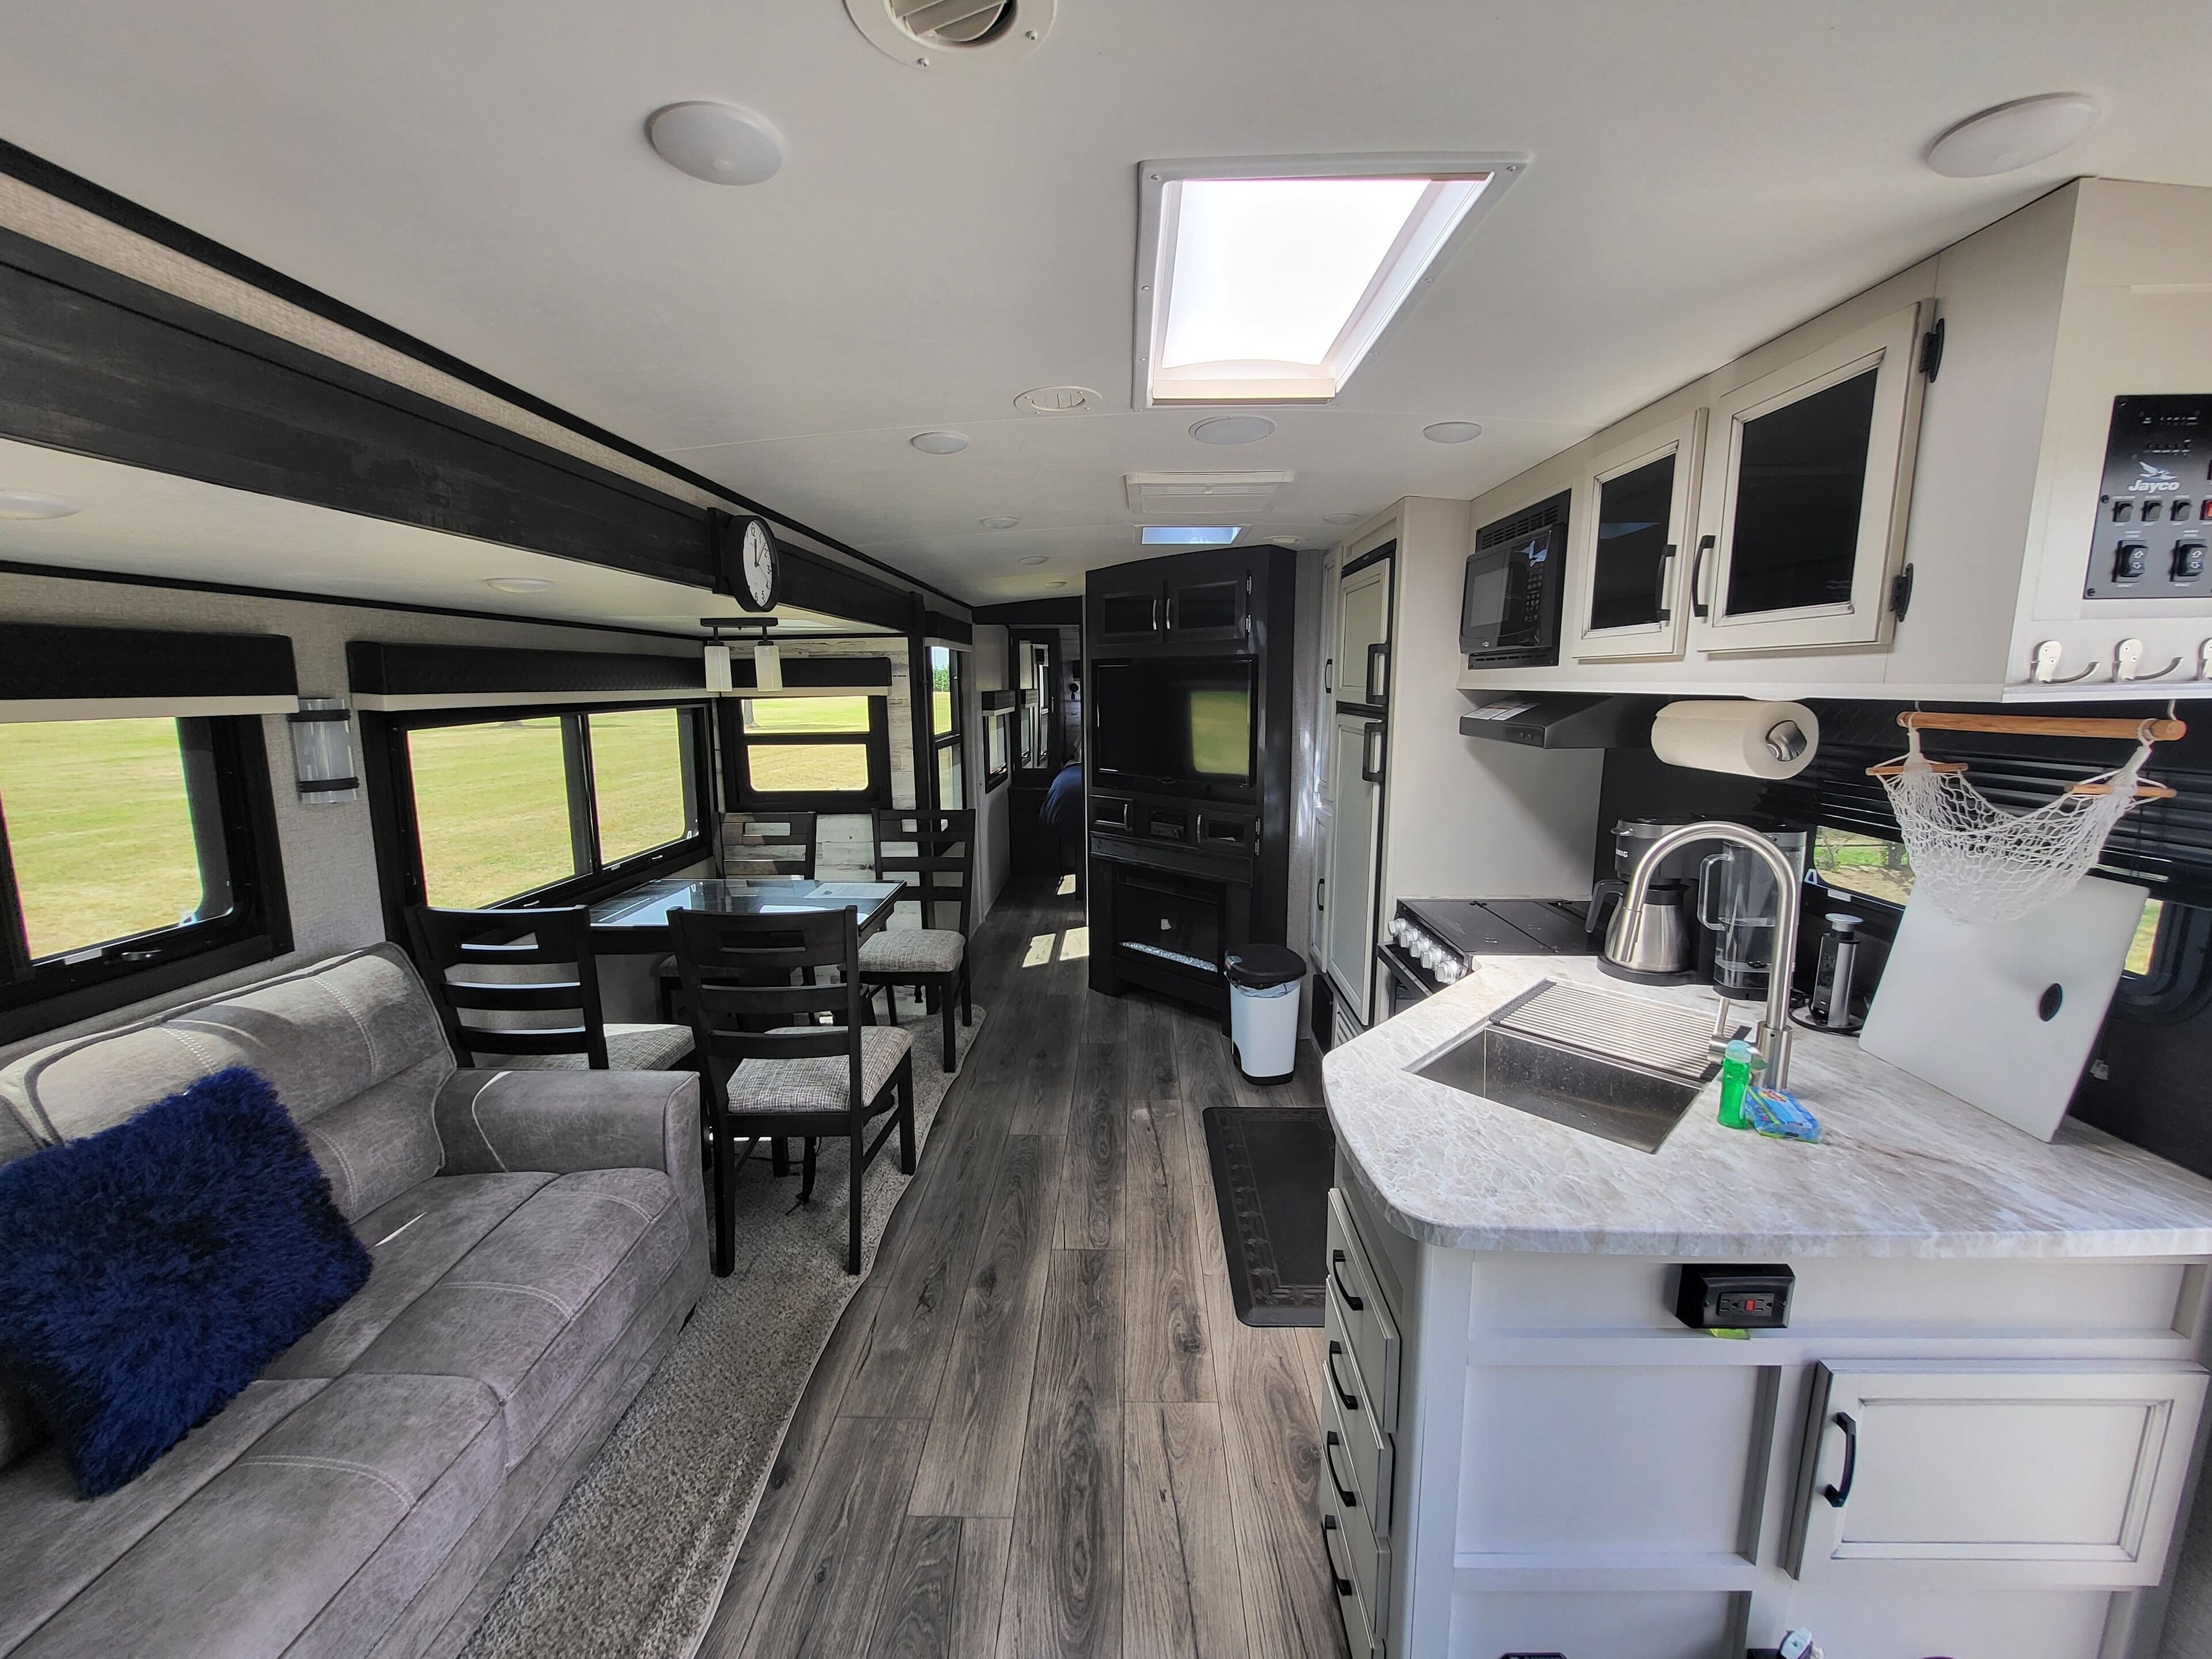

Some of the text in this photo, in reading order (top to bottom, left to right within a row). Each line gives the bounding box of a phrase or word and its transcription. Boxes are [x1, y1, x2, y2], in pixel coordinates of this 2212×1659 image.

[2128, 479, 2180, 494] Jayco
[751, 525, 756, 537] 12
[764, 548, 768, 558] 2
[767, 565, 771, 575] 3
[766, 580, 769, 589] 4
[755, 592, 758, 601] 6
[761, 590, 765, 600] 5
